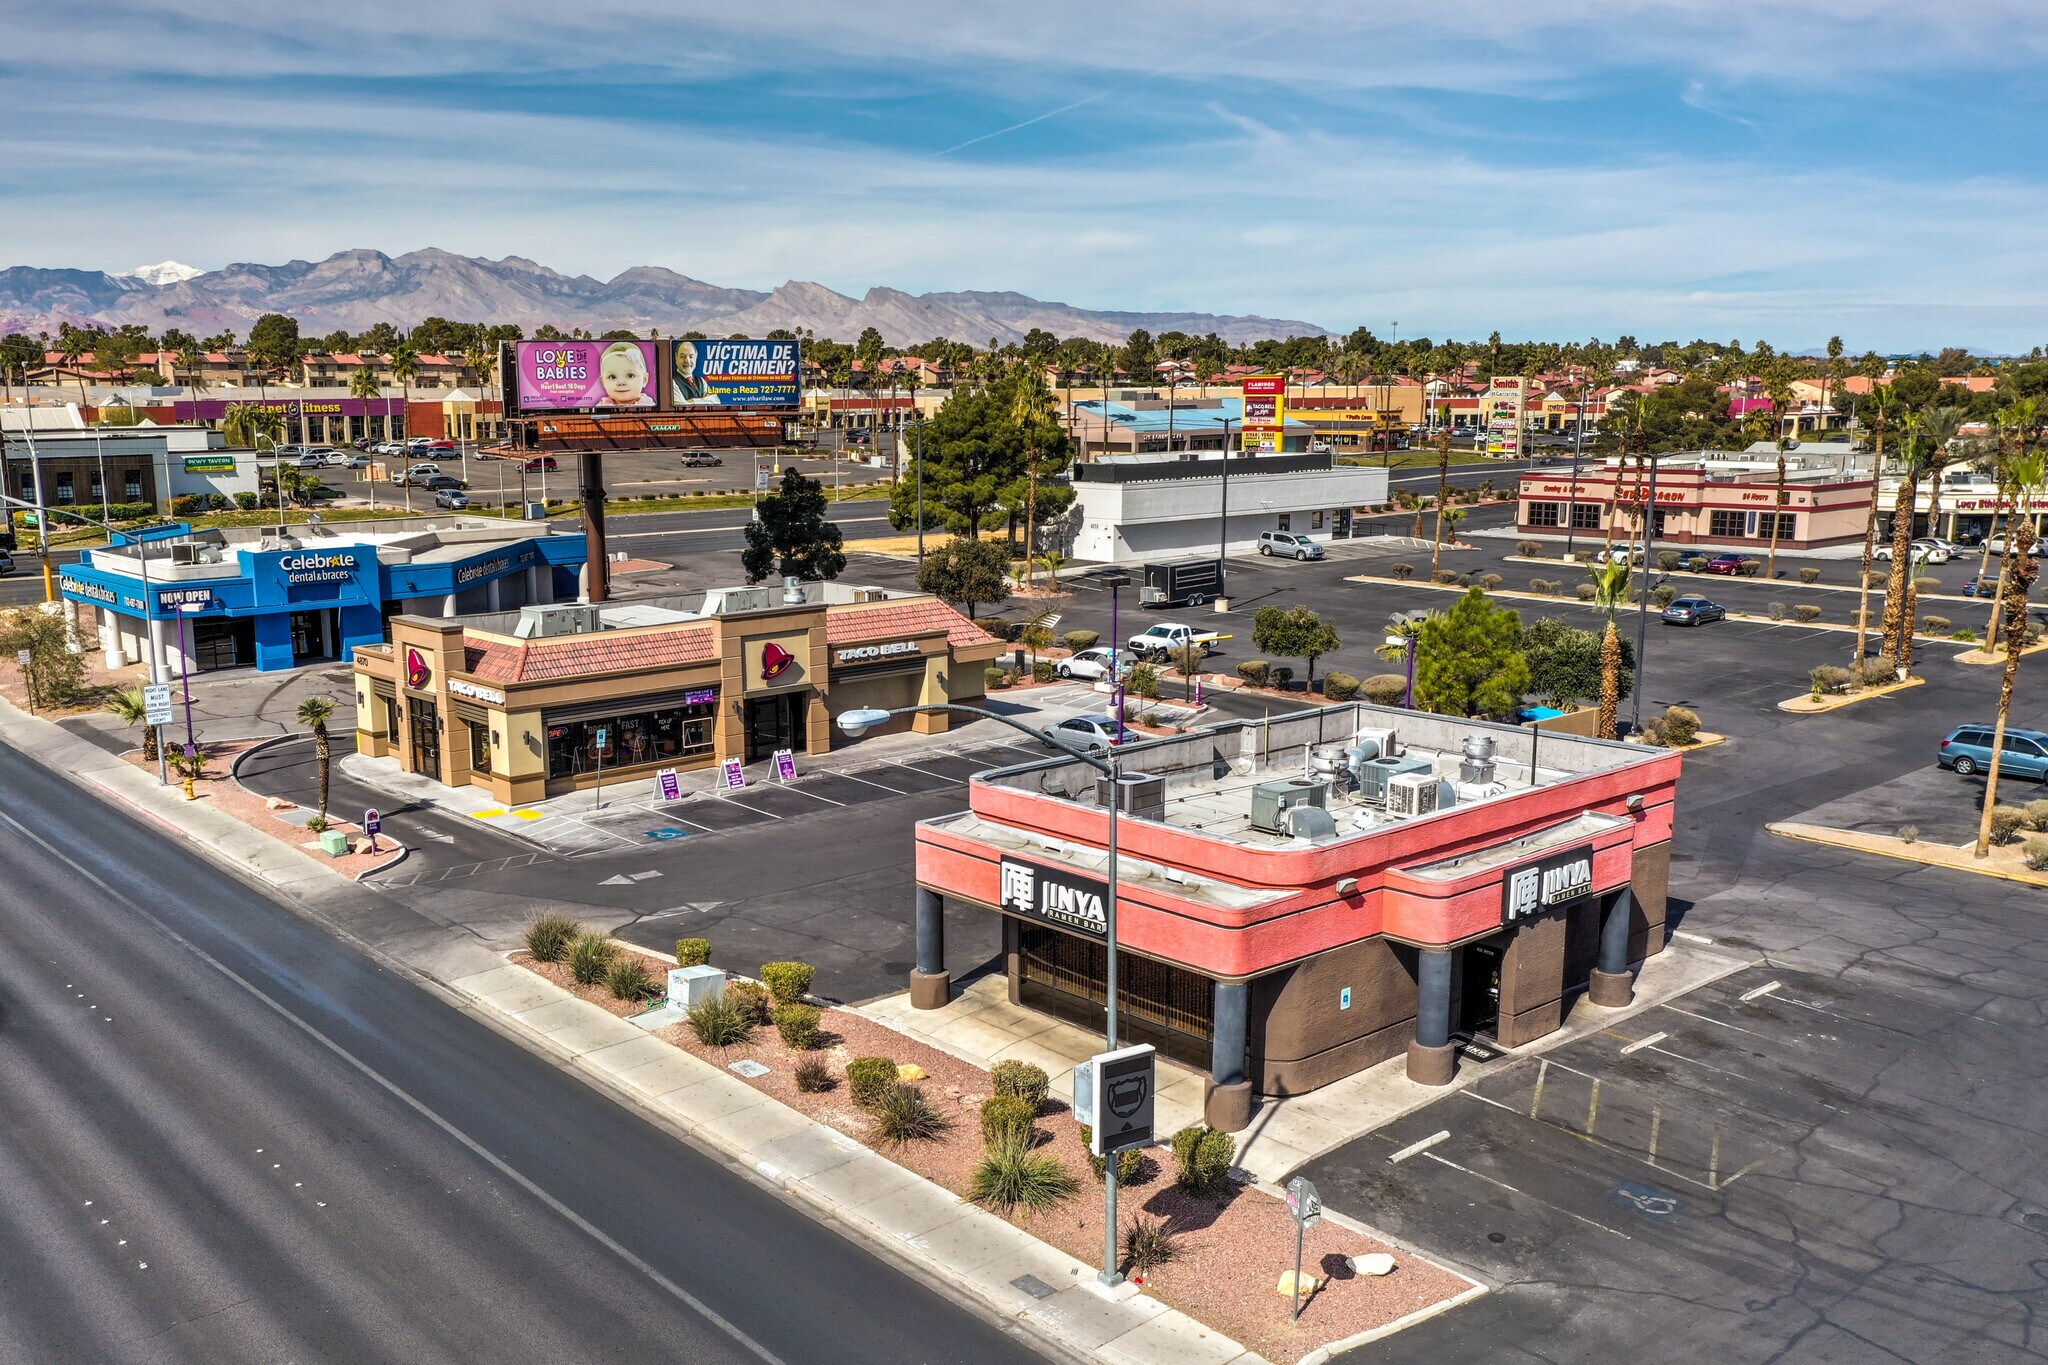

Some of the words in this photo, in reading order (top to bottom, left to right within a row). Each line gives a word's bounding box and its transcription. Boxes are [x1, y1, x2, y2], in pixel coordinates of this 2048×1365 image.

[535, 350, 575, 366] LOVE
[707, 342, 767, 360] VÍCTIMA
[772, 345, 793, 359] DE
[537, 366, 587, 379] BABIES
[703, 360, 724, 375] UN
[728, 360, 796, 375] CRIMEN?
[708, 386, 731, 394] Llame
[739, 386, 758, 394] Reza
[761, 385, 796, 394] 727-7777
[1493, 378, 1519, 388] Smith's
[1642, 487, 1685, 502] DAGON
[1955, 499, 1976, 509] Lucy
[279, 553, 354, 571] Celebrate
[60, 575, 84, 595] Celebrate
[160, 592, 184, 604] NOW
[185, 590, 210, 602] OPEN
[837, 646, 879, 660] TACO
[880, 641, 920, 655] BELL
[356, 656, 369, 667] 4870
[447, 679, 476, 698] TACO
[475, 685, 505, 705] BELL
[621, 720, 639, 730] FAST
[1541, 859, 1591, 905] JINYA
[1041, 881, 1106, 922] JINYA
[1551, 889, 1575, 903] RAMEN
[1577, 884, 1591, 894] BAR
[1049, 909, 1080, 925] RAMEN
[1083, 921, 1103, 932] BAR
